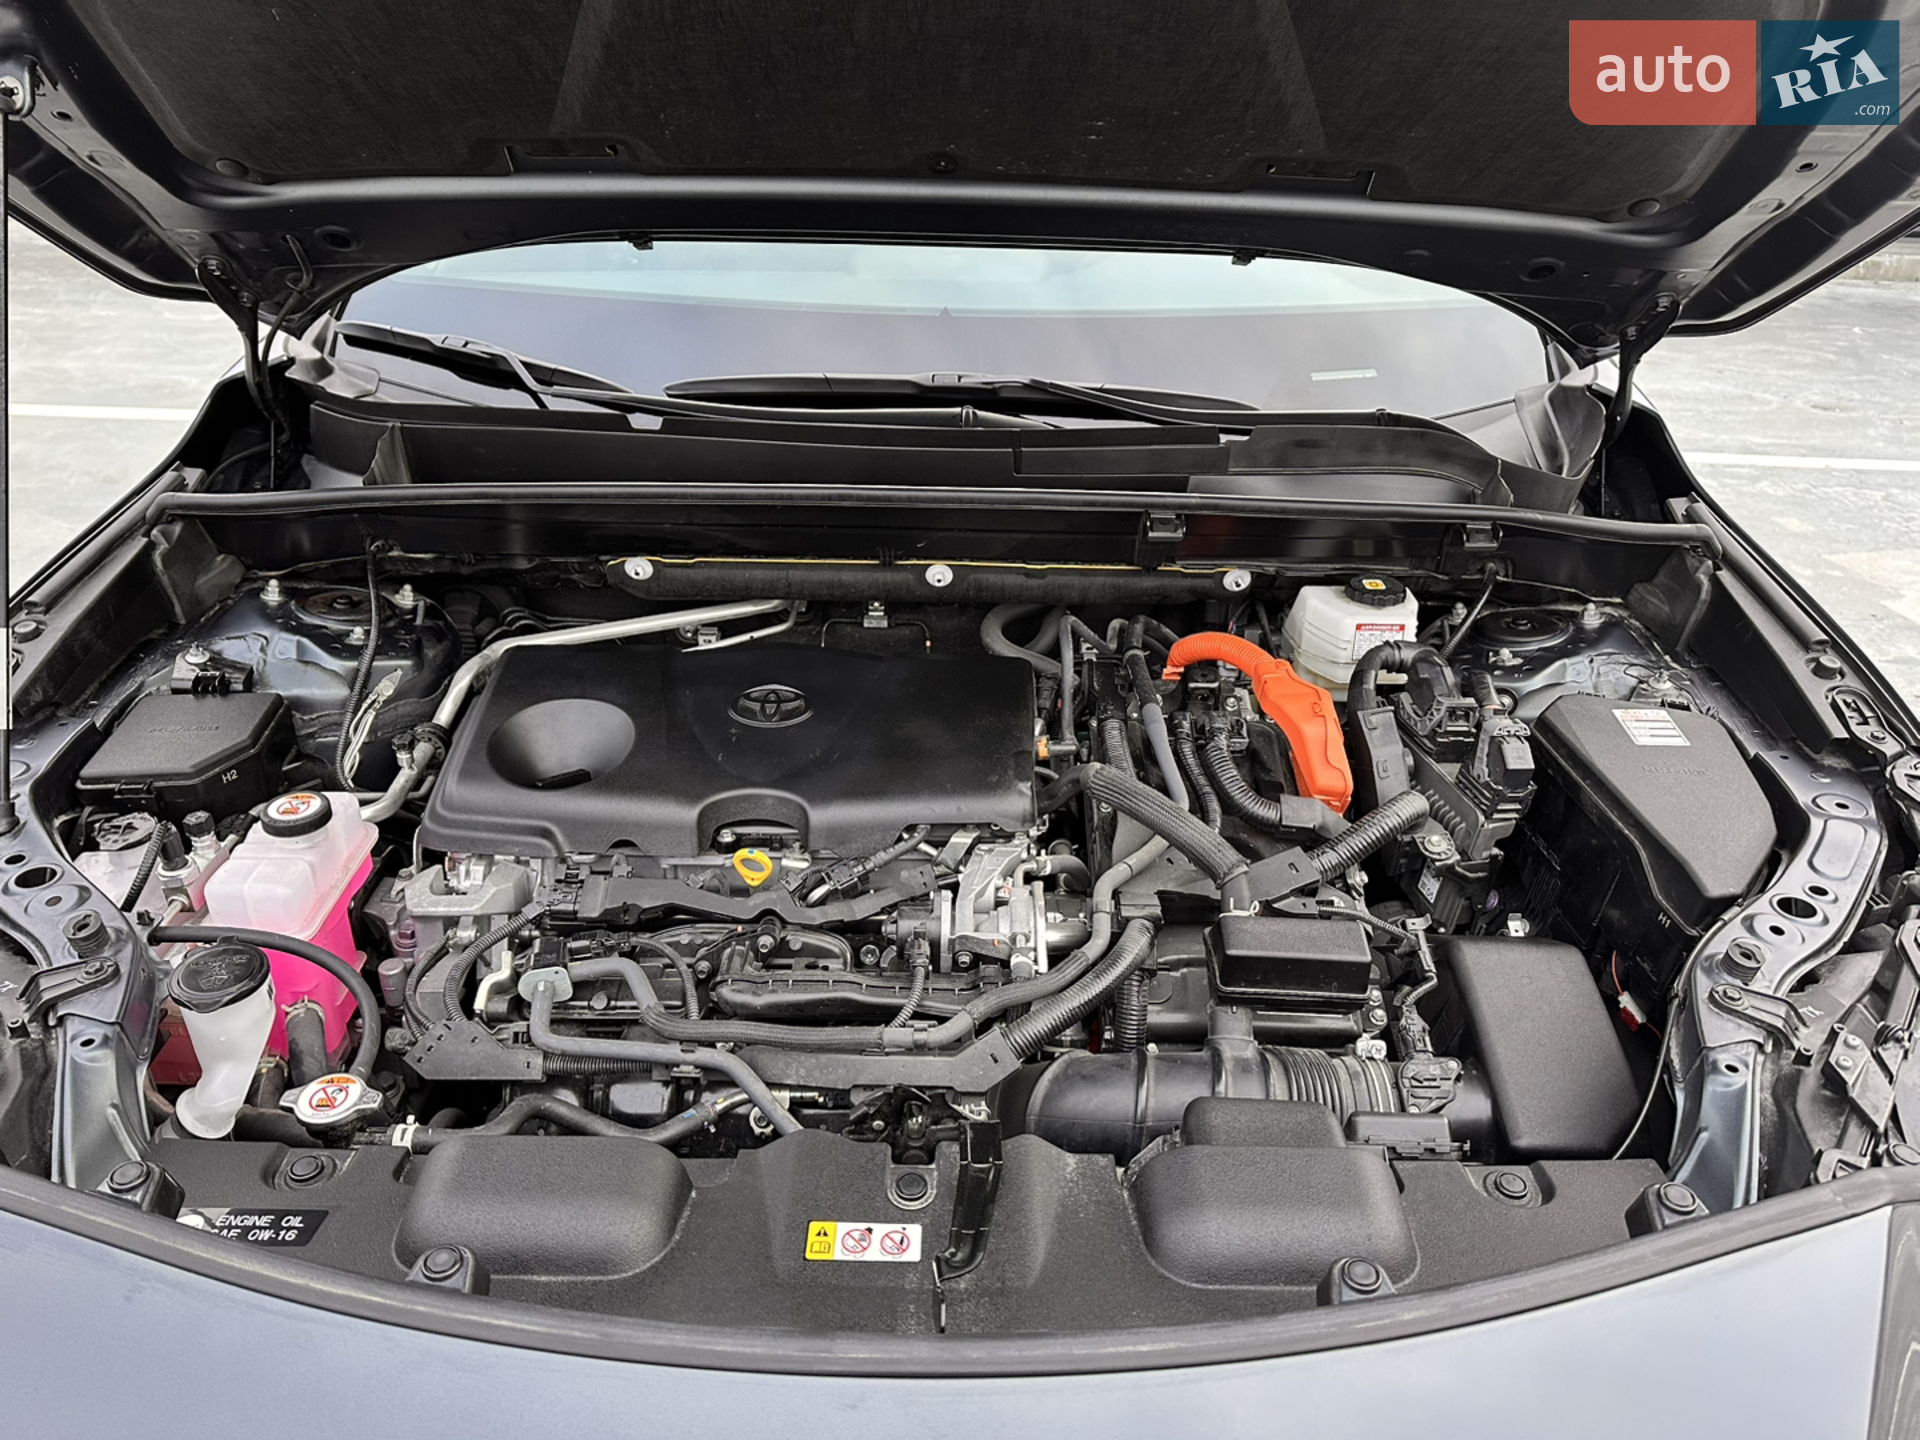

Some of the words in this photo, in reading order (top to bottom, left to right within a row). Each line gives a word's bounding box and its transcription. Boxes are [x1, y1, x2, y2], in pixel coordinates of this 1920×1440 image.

[221, 769, 239, 784] H2
[1657, 911, 1672, 928] H1
[214, 1215, 275, 1227] ENGINE
[280, 1215, 305, 1228] OIL
